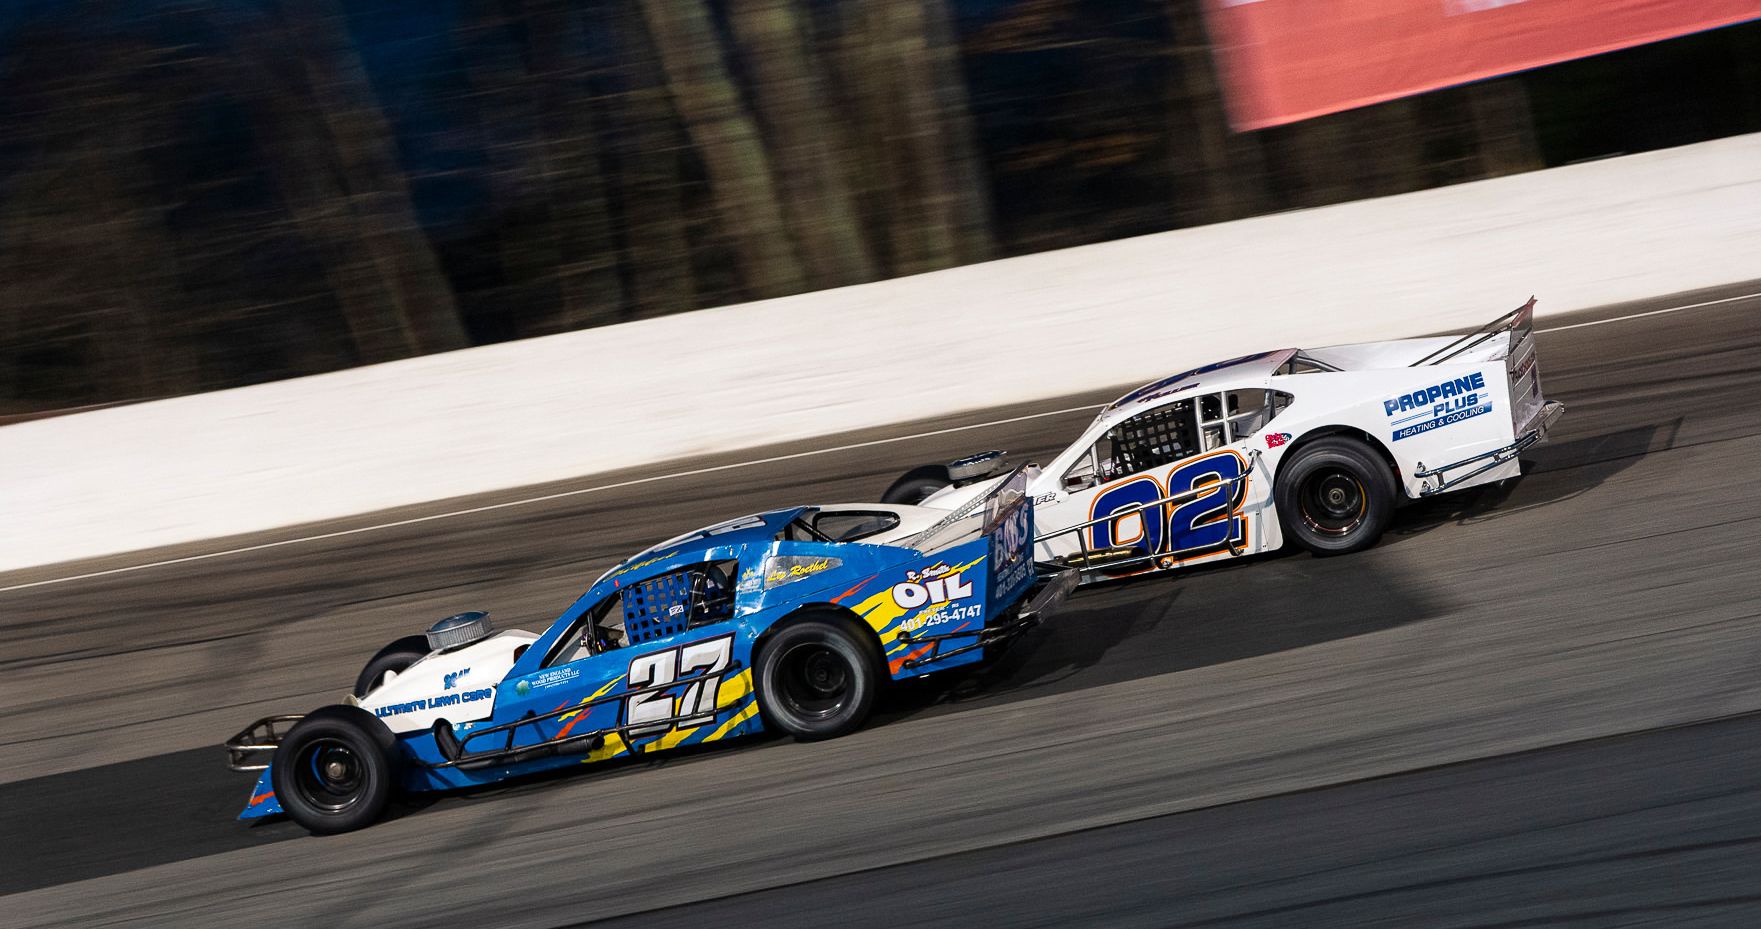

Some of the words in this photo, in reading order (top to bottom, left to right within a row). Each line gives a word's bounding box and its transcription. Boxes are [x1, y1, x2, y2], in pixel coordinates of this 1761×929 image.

[1383, 371, 1486, 417] PROPANE
[1433, 393, 1479, 417] PLUS
[1400, 420, 1436, 438] HEATING
[1438, 416, 1445, 426] &
[1446, 405, 1485, 423] COOLING
[1088, 449, 1249, 578] 02
[788, 559, 829, 577] Roethel
[892, 571, 973, 610] OIL
[899, 604, 982, 632] 401-295-4747
[531, 677, 547, 687] WOOD
[547, 671, 571, 683] PRODUCTS
[539, 671, 550, 680] NEW
[550, 667, 572, 677] ENGLAND
[626, 631, 736, 741] 27
